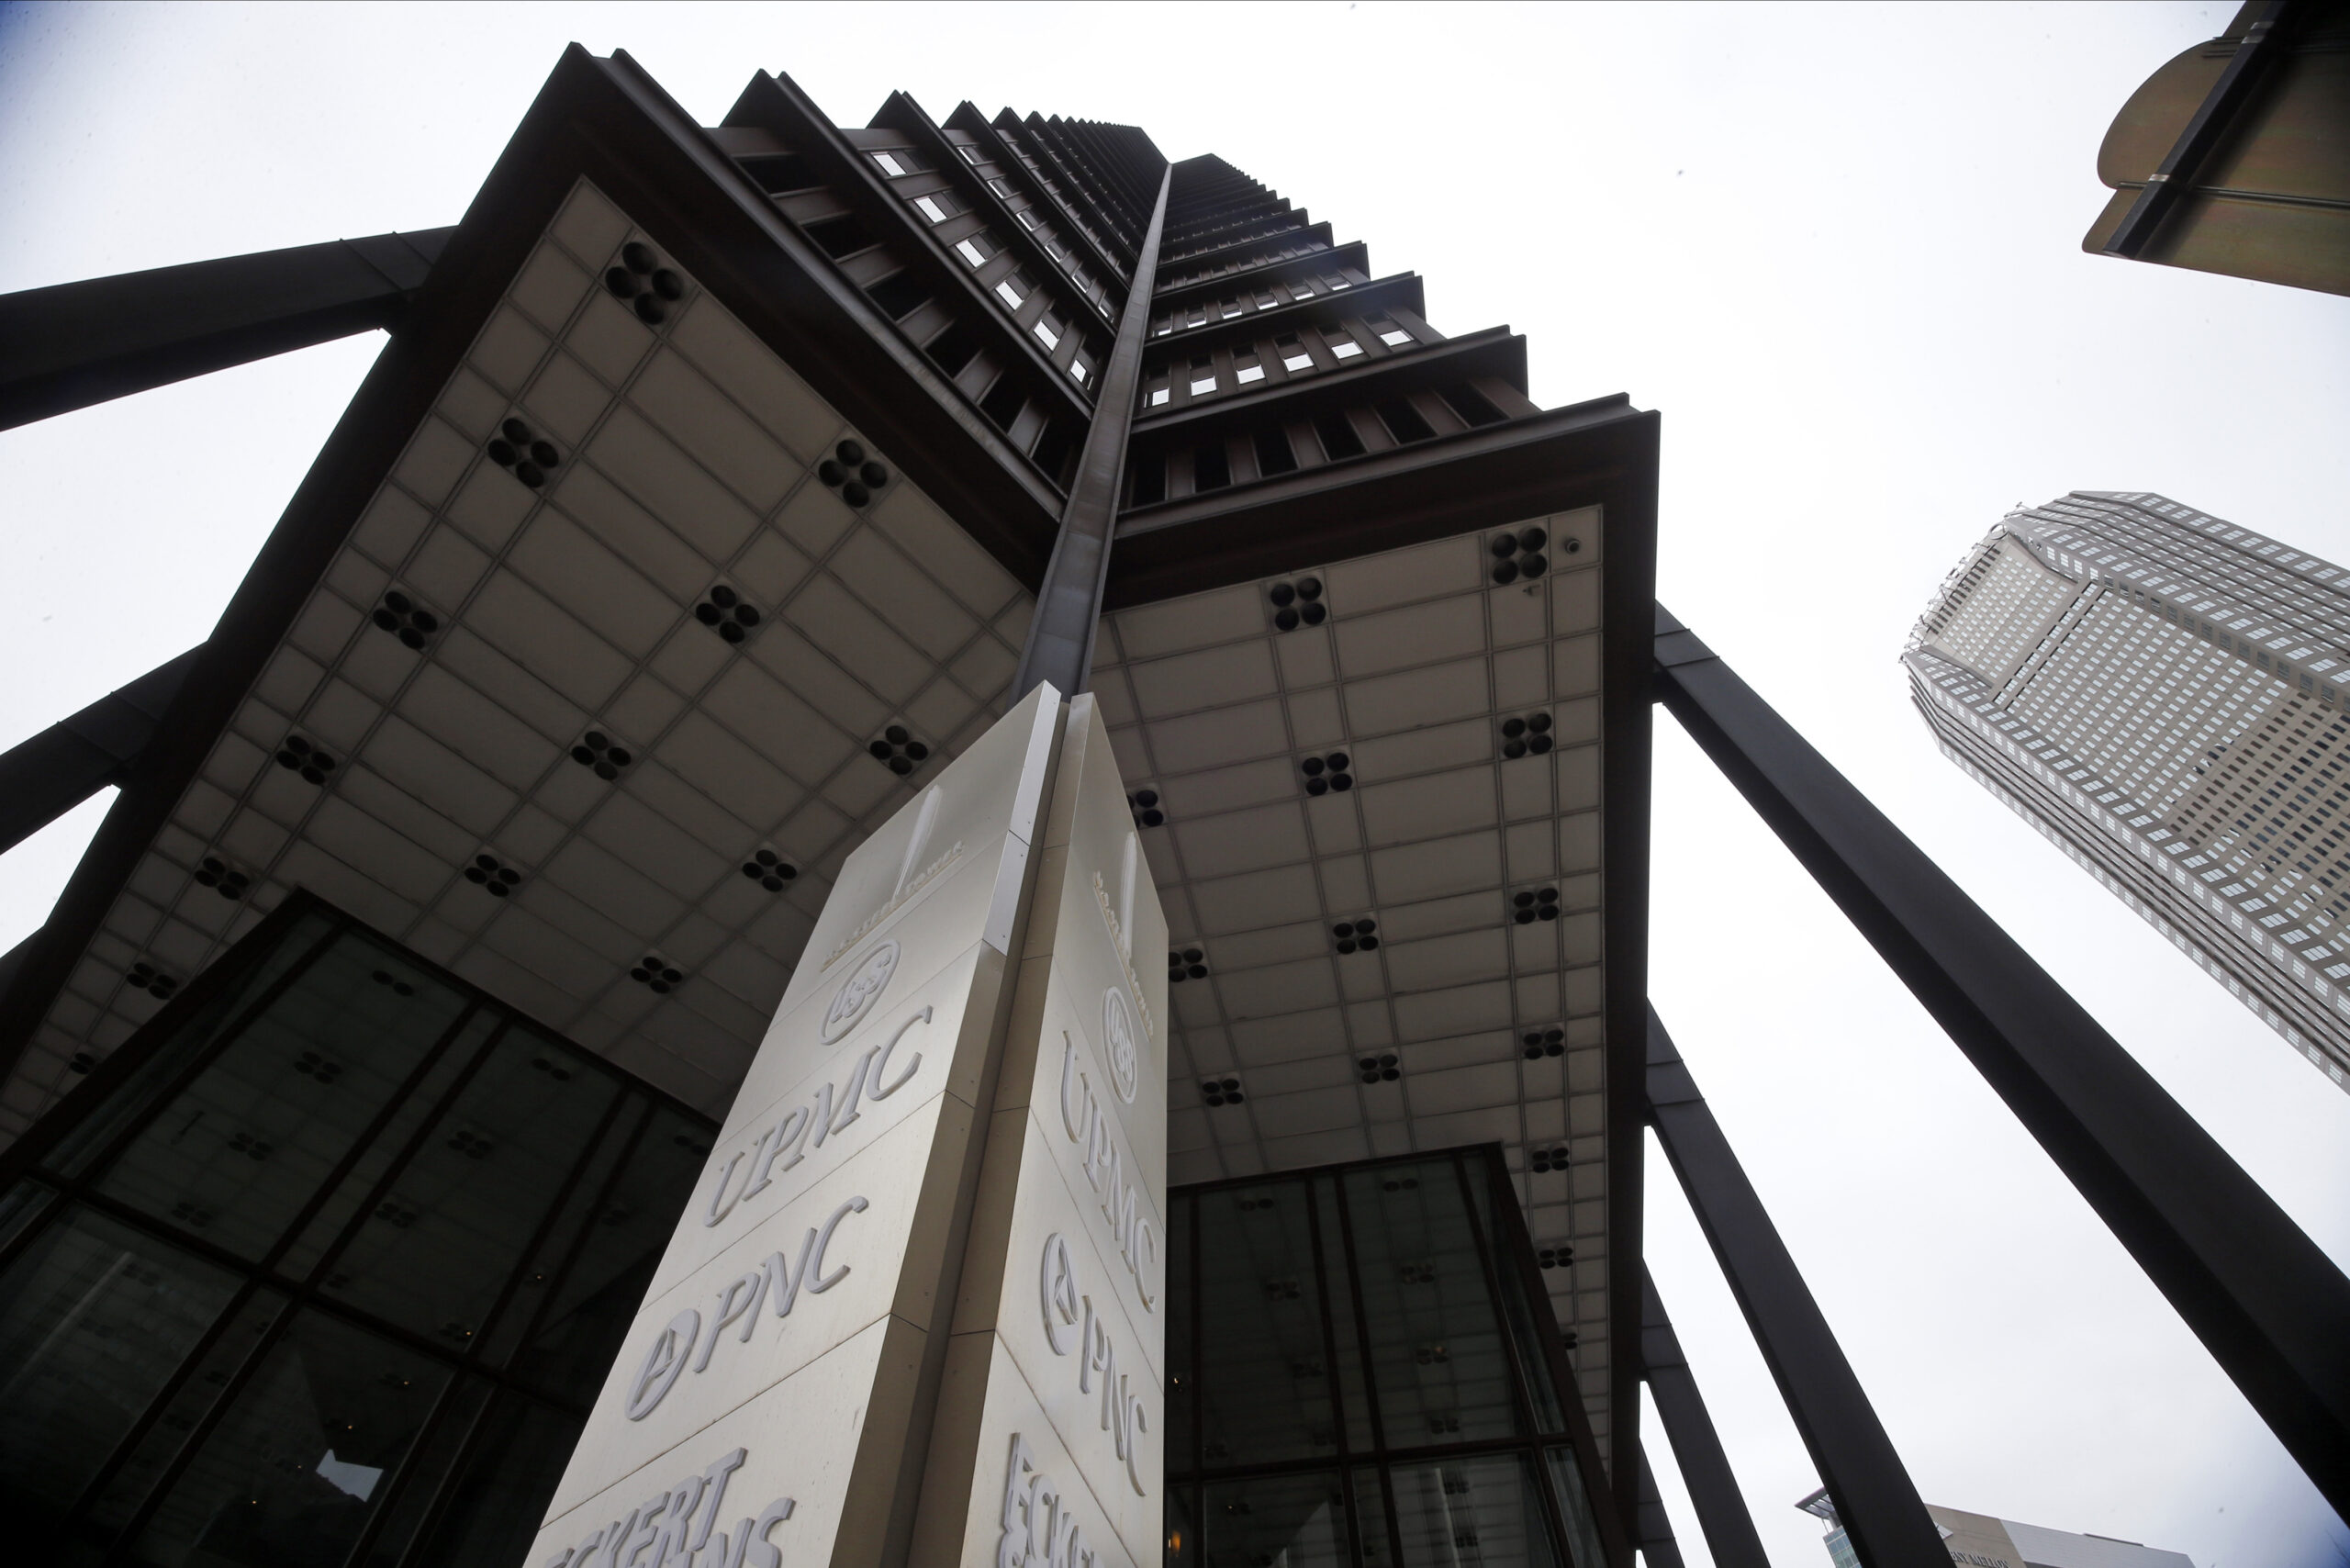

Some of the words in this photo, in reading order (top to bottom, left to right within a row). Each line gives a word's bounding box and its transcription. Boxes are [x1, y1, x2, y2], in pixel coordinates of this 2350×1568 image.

[703, 1004, 934, 1227] UPMC
[1061, 1030, 1157, 1314] UPMC
[693, 1195, 869, 1374] PNC
[1080, 1295, 1147, 1496] PNC
[543, 1447, 748, 1568] KERT
